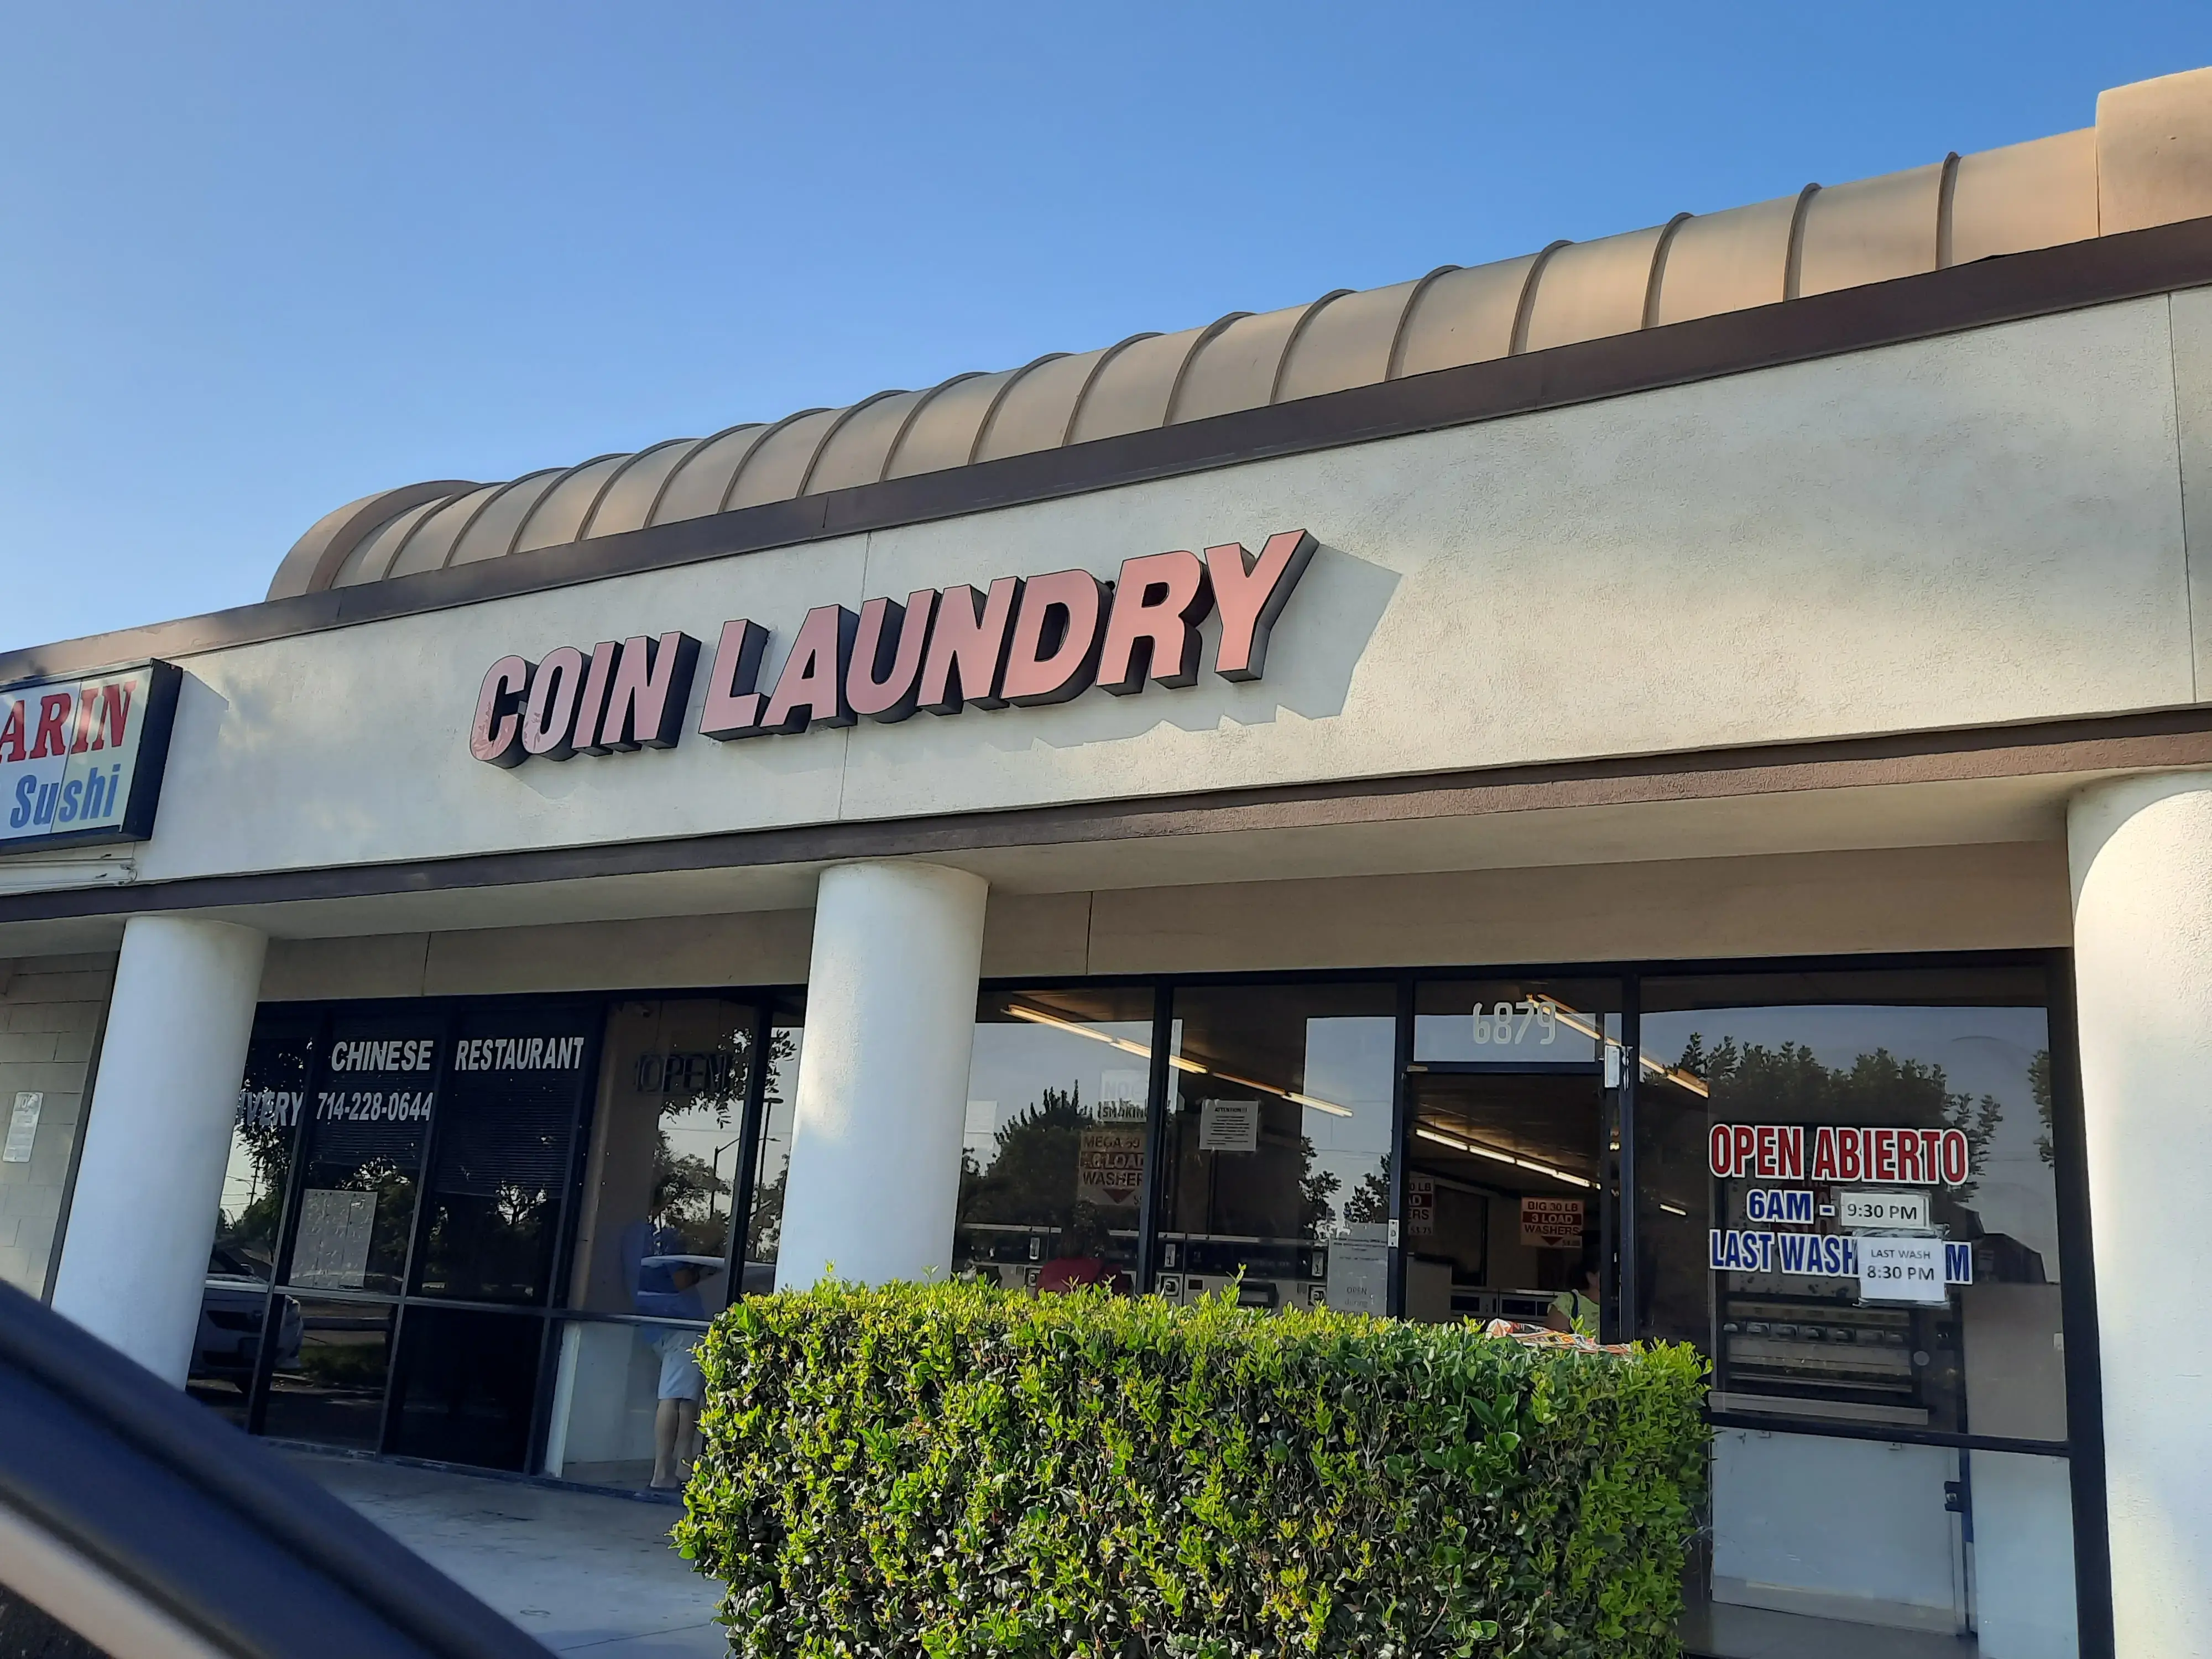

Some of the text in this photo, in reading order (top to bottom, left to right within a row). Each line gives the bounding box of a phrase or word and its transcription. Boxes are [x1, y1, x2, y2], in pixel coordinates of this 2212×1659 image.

[470, 529, 1318, 766] COIN LAUNDRY
[9, 763, 121, 829] Sushi
[1473, 1001, 1556, 1045] 6879
[331, 1037, 585, 1071] CHINESE RESTAURANT
[316, 1092, 433, 1121] 714-228-0644
[1084, 1135, 1121, 1149] MEGA
[1709, 1123, 1969, 1186] OPEN ABIERTO
[1418, 1182, 1431, 1192] LB
[1527, 1201, 1578, 1212] BIG 30 LB
[1746, 1189, 1814, 1224] 6AM
[1847, 1203, 1918, 1220] 9:30 PM
[1531, 1213, 1573, 1224] 3 LOAD
[1524, 1224, 1581, 1235] WASHERS
[1709, 1229, 1775, 1273] LAST
[1871, 1249, 1931, 1260] LAST WASH
[1867, 1265, 1934, 1281] 8:30 PM
[1346, 1286, 1368, 1295] OPEN
